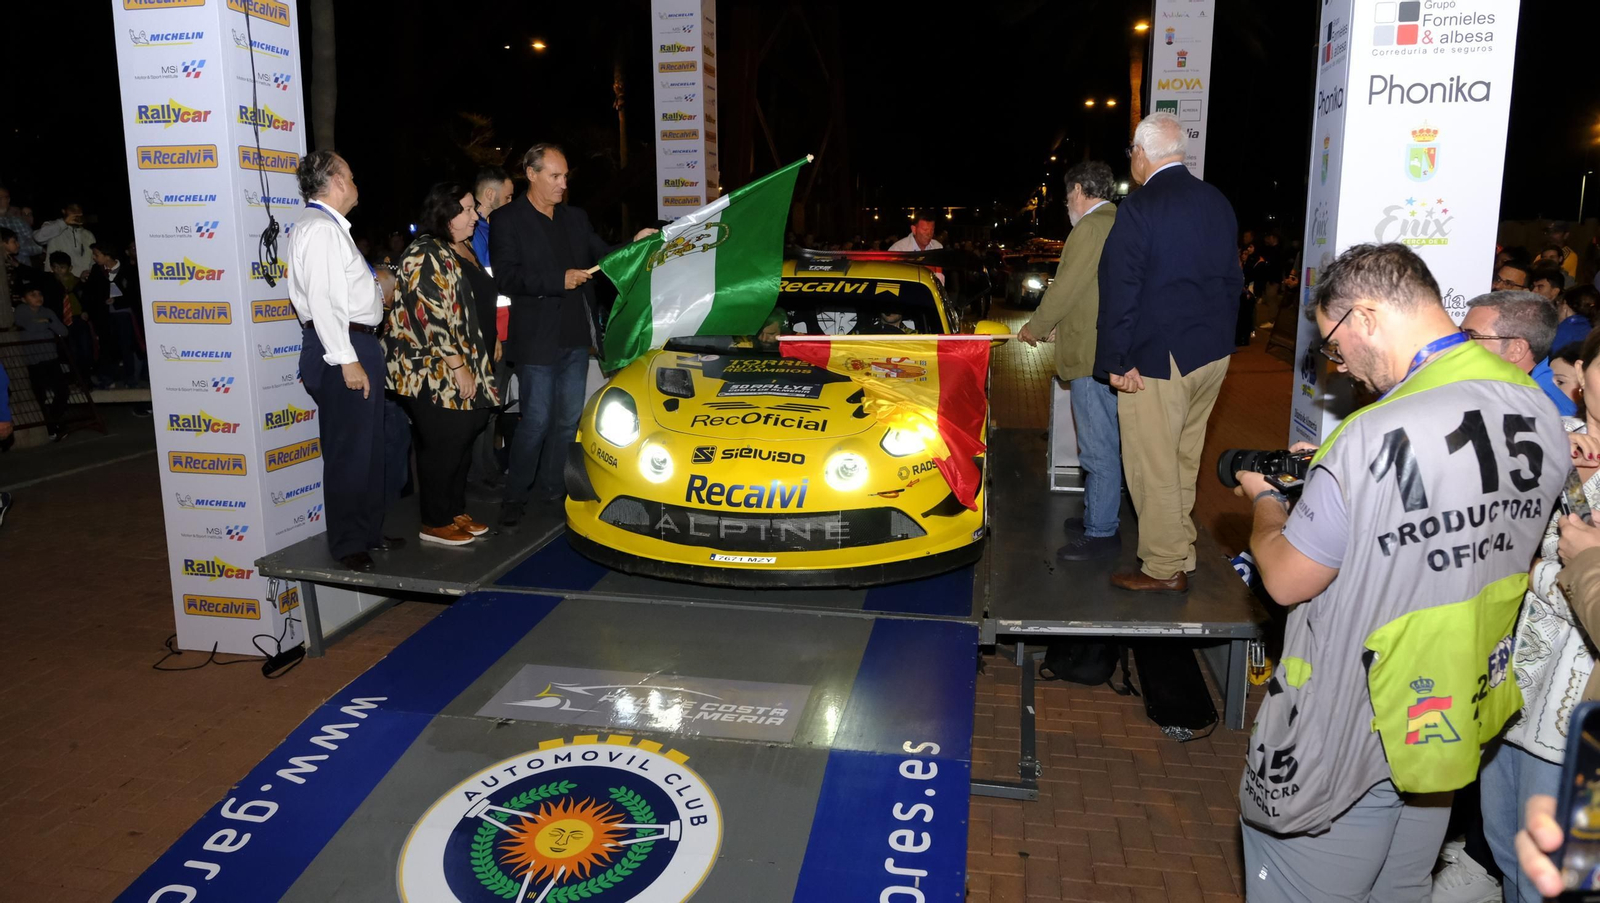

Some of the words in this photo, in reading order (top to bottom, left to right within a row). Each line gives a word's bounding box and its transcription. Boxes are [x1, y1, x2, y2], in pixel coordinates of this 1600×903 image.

[1424, 0, 1456, 10] Grupo
[1422, 12, 1496, 27] Fornieles
[149, 31, 204, 42] MICHELIN
[1421, 29, 1434, 45] &
[1439, 30, 1494, 44] albesa
[250, 39, 290, 57] MICHELIN
[1433, 46, 1446, 54] de
[1451, 45, 1493, 55] seguros
[161, 65, 178, 74] MSi
[1368, 74, 1492, 106] Phonika
[137, 103, 212, 124] Rallycar
[153, 149, 201, 165] Recalvi
[163, 194, 217, 203] MICHELIN
[175, 226, 192, 234] MSi
[1374, 205, 1454, 246] Enix
[152, 261, 225, 281] Rallycar
[169, 305, 216, 320] Recalvi
[180, 350, 232, 359] MICHELIN
[273, 344, 302, 355] MICHEL
[730, 359, 815, 367] TORRE
[168, 413, 241, 435] Rallycar
[265, 407, 317, 429] Rallycar
[690, 411, 828, 433] RecOficial
[184, 455, 231, 471] Recalvi
[277, 444, 311, 465] Recalvi
[596, 447, 618, 469] RADSA
[1369, 409, 1544, 513] 115
[911, 460, 939, 476] RADS
[285, 480, 321, 500] MICHELIN
[685, 473, 809, 509] Recalvi
[195, 498, 246, 508] MICHELIN
[654, 513, 850, 542] ALPINE
[1377, 498, 1542, 557] PRODUCTORA
[1426, 532, 1514, 572] OFICIAL
[184, 558, 254, 580] Rallycar
[199, 599, 245, 615] Recalvi
[699, 701, 789, 717] COSTA
[668, 710, 785, 727] LMERIA
[463, 750, 650, 802] AUTOMOVIL
[664, 772, 708, 827] CLUB
